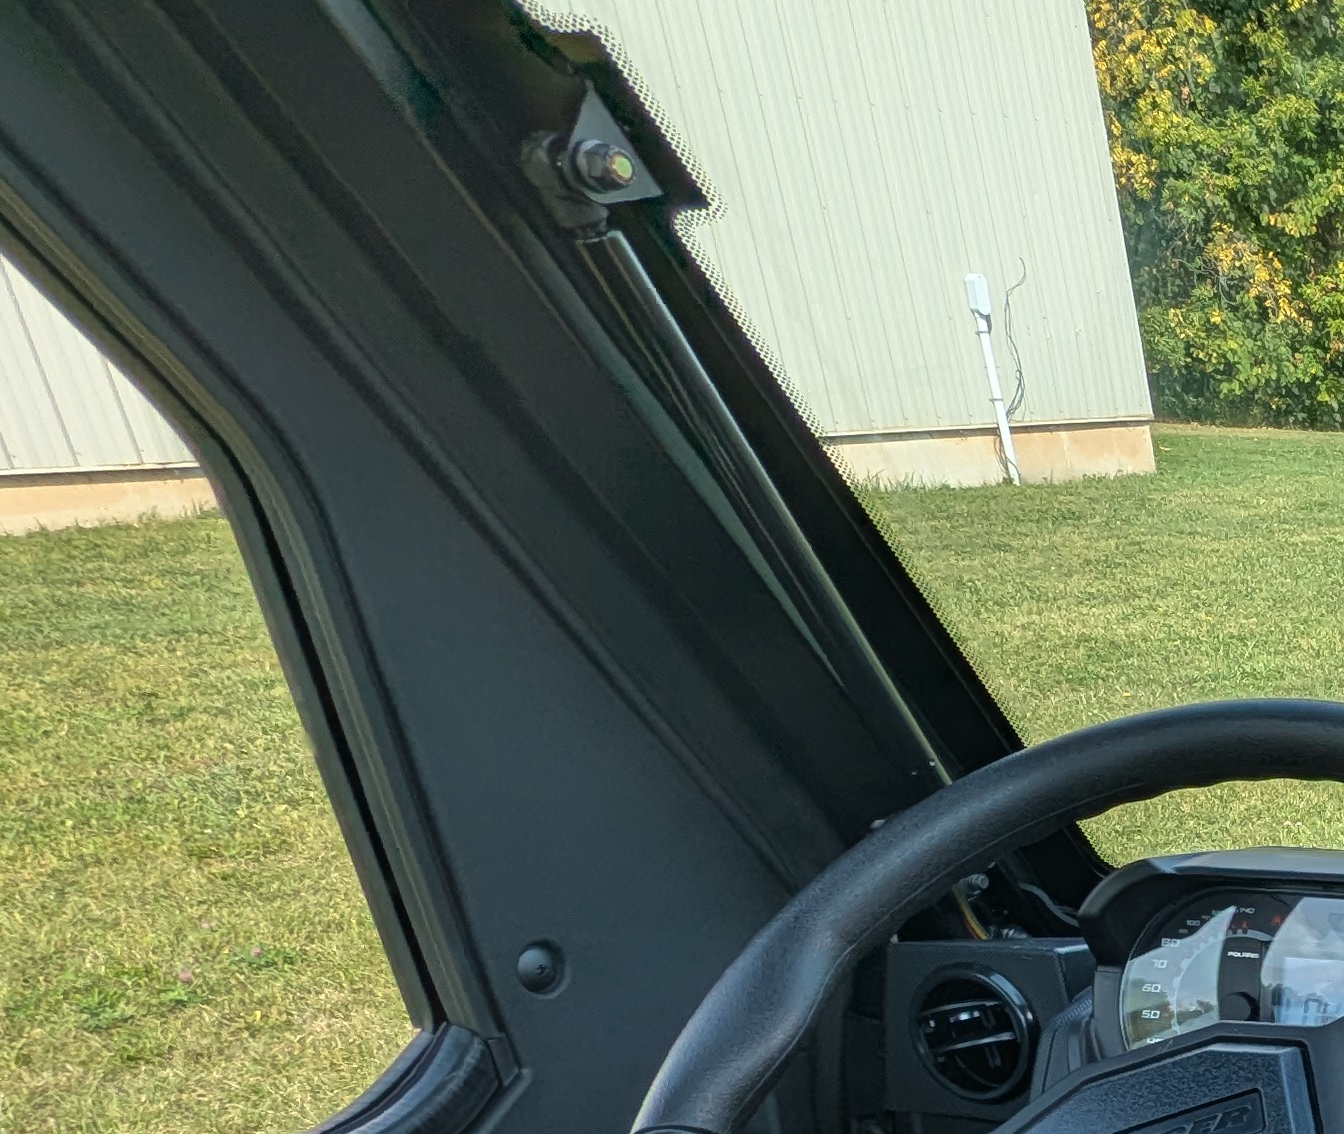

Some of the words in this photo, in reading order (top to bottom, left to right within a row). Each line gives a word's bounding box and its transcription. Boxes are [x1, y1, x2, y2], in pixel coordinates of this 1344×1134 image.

[1162, 938, 1180, 947] 80
[1227, 951, 1260, 959] POLARIS
[1151, 959, 1167, 968] 70
[1142, 984, 1161, 993] 60
[1141, 1009, 1160, 1019] 50
